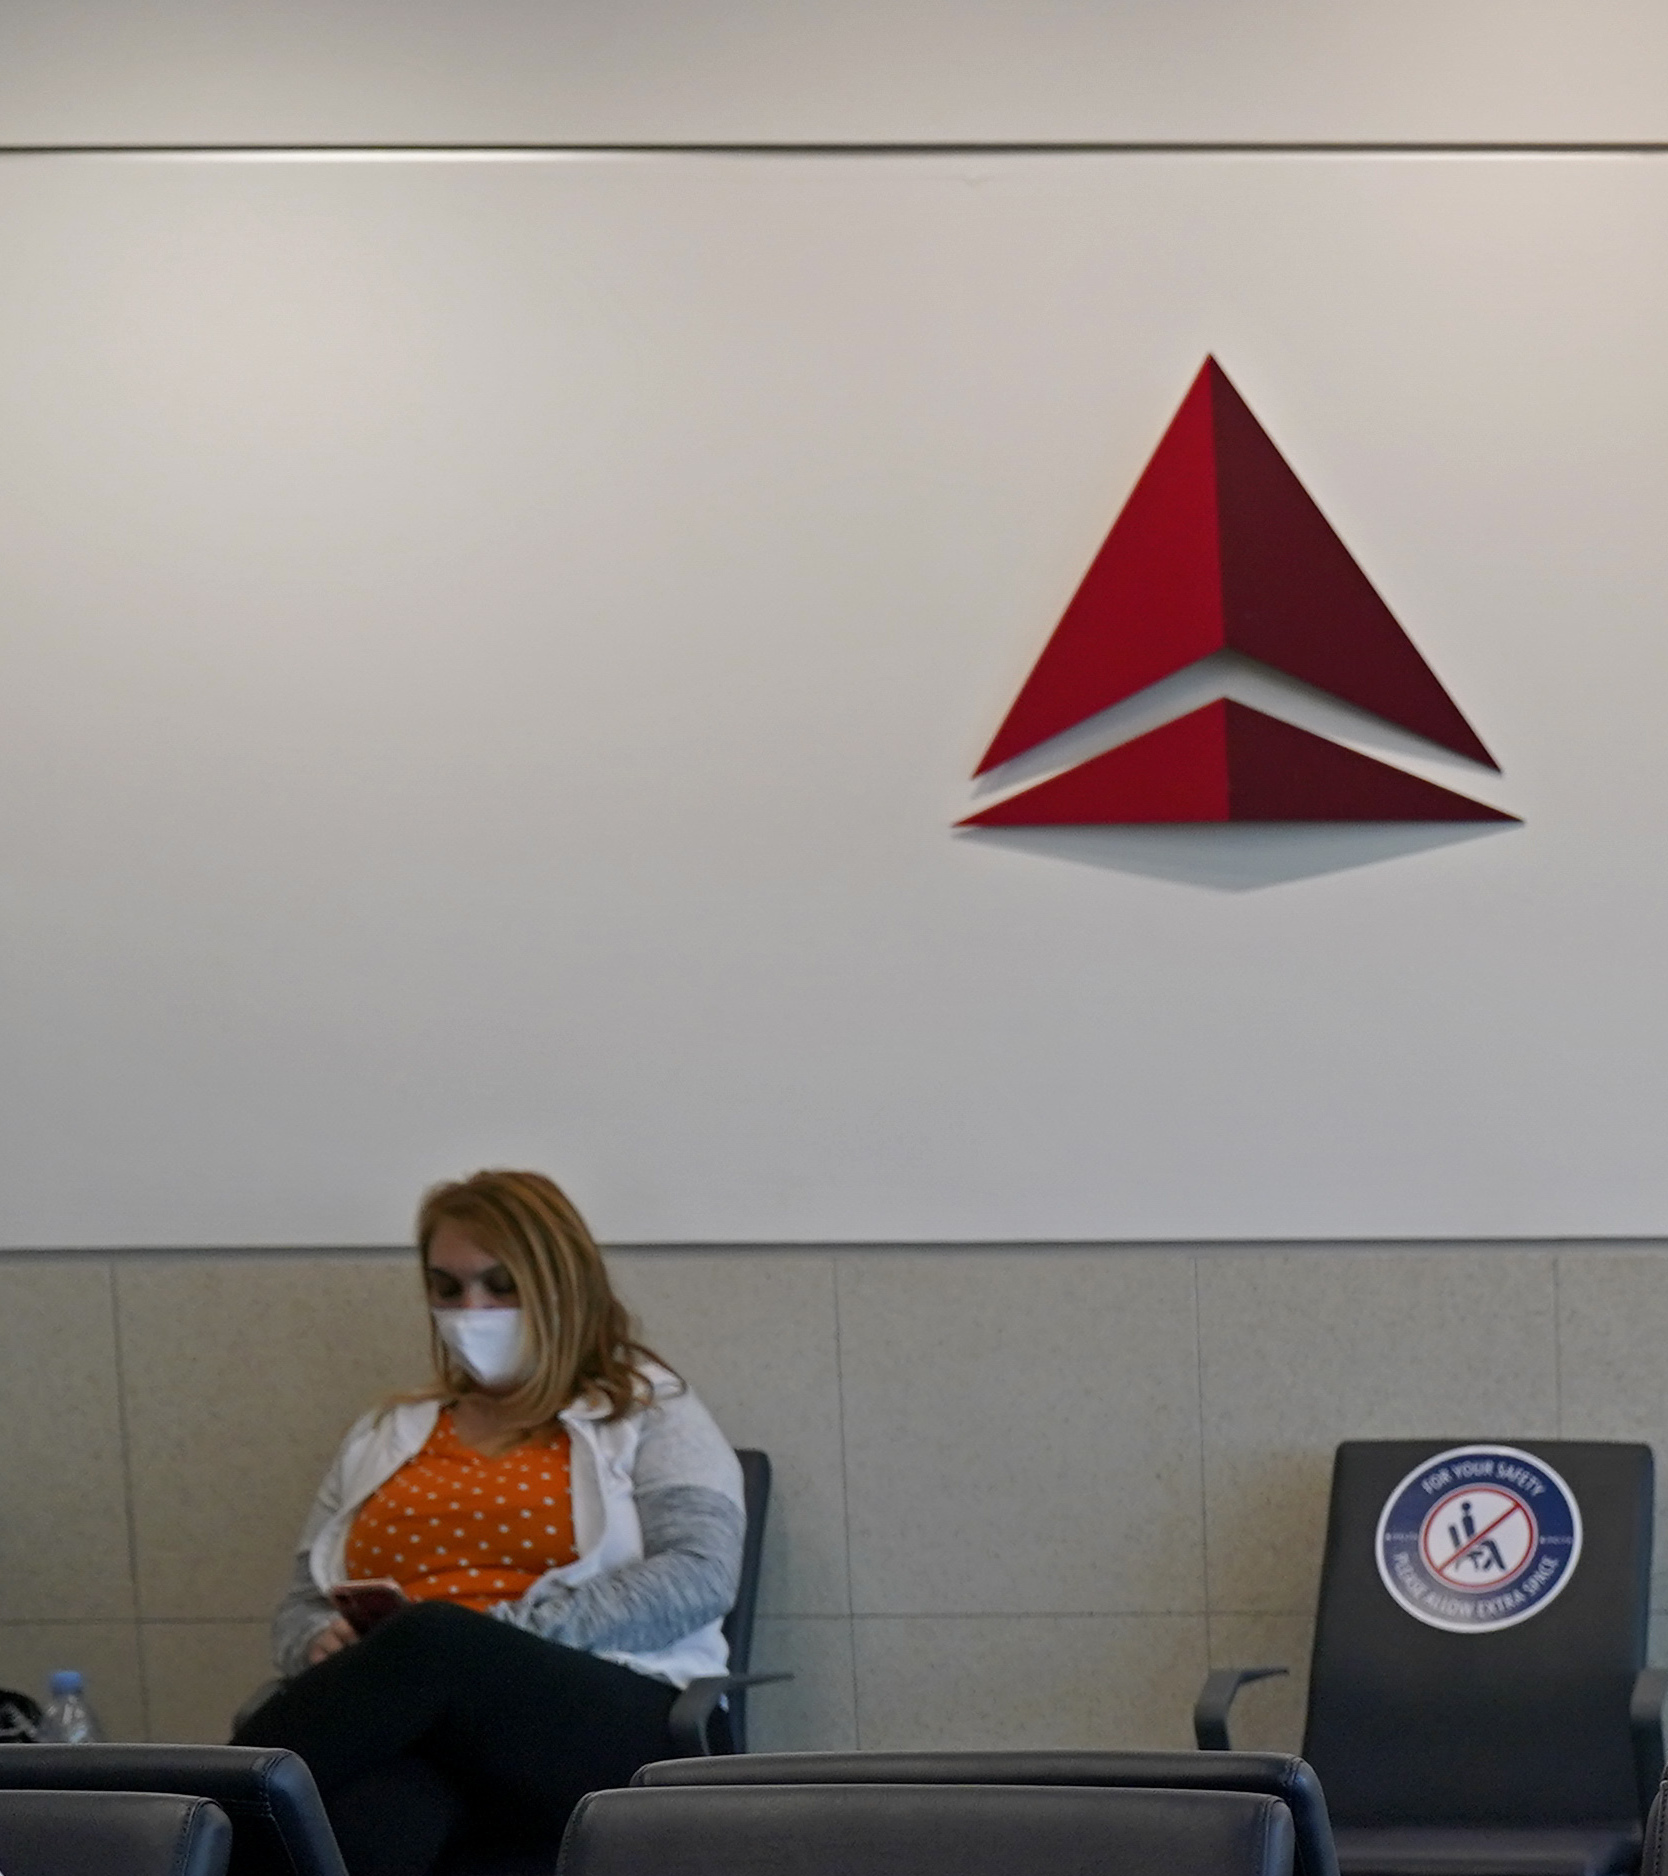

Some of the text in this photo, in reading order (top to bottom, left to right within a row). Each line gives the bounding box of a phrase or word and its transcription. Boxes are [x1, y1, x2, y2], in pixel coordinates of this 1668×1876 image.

[1421, 1460, 1547, 1496] FOR YOUR SAFETY
[1393, 1551, 1560, 1619] PLEASE ALLOW EXTRA SPACE
